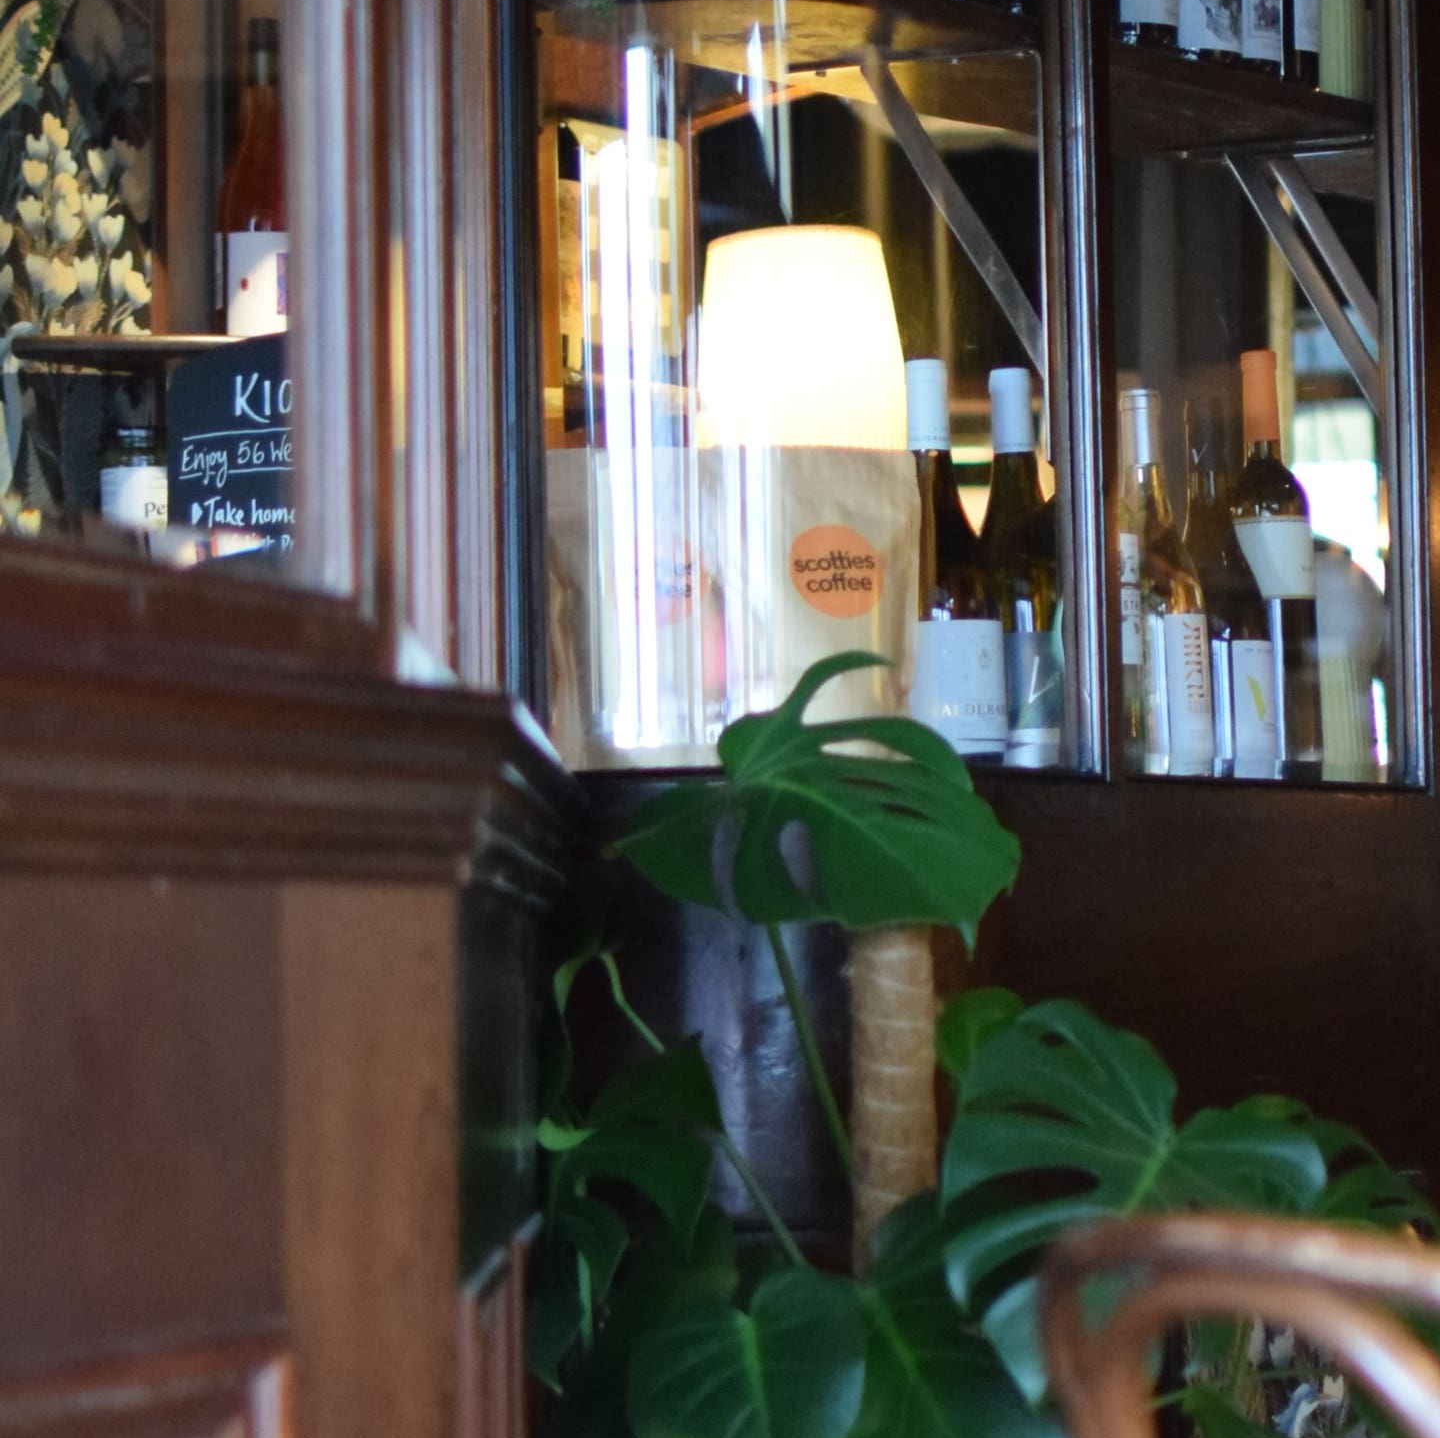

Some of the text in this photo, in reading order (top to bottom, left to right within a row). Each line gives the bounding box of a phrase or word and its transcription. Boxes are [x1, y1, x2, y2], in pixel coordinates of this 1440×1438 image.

[234, 372, 293, 423] KIO
[181, 445, 228, 488] Enjoy
[237, 439, 265, 464] 56
[204, 496, 245, 528] Take
[794, 550, 875, 573] scotties
[806, 572, 872, 593] coffee
